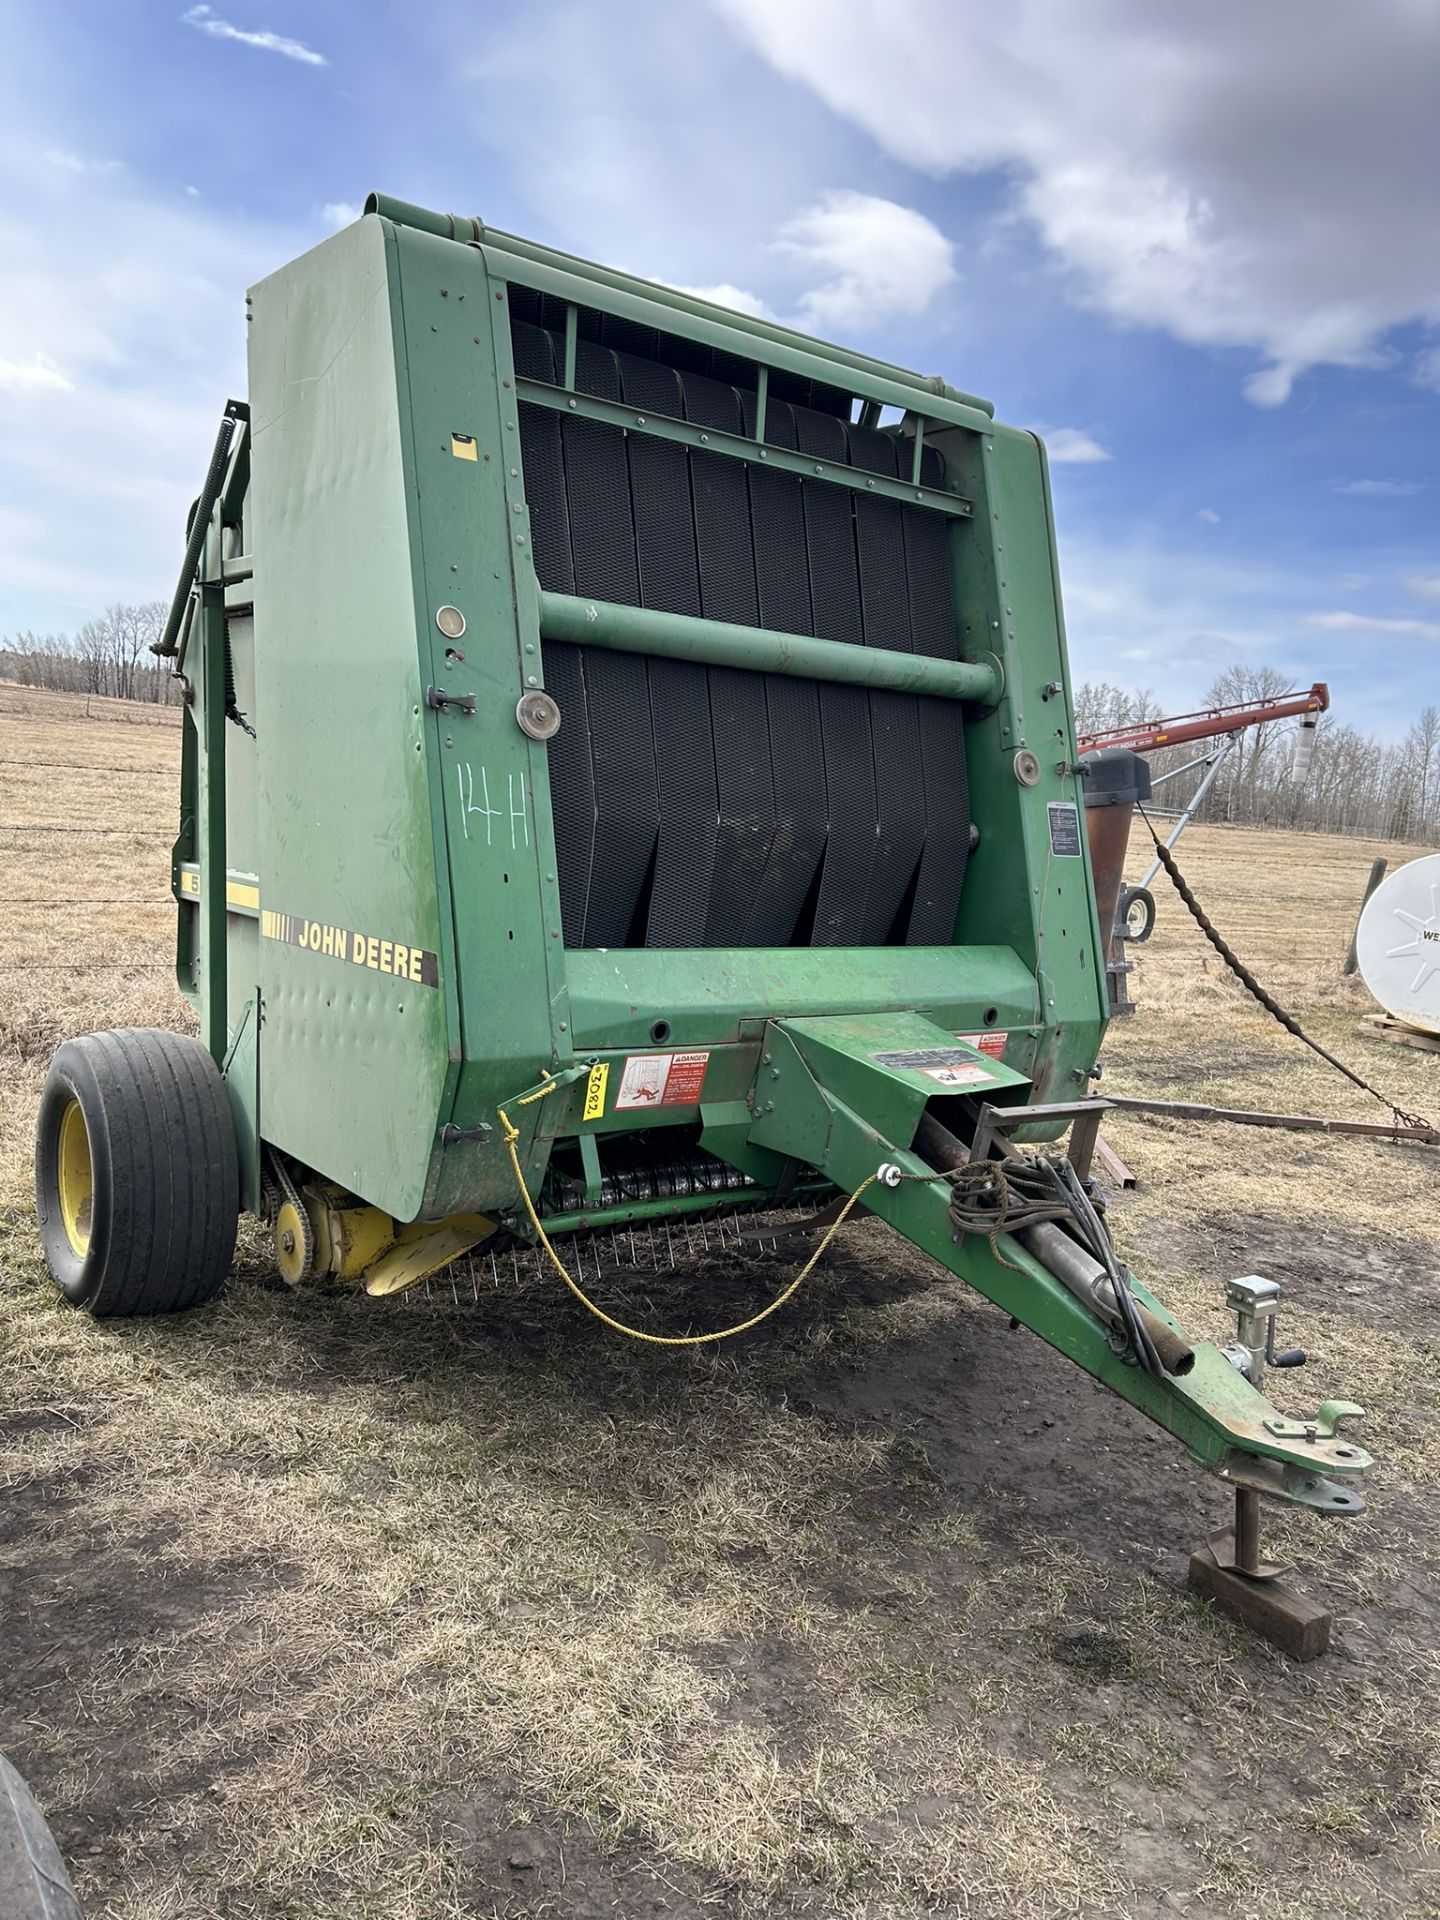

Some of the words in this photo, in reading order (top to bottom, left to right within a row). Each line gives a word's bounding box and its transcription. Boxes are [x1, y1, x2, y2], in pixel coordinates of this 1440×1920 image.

[1423, 930, 1440, 942] WE
[298, 919, 347, 960] JOHN
[353, 932, 423, 983] DEERE
[681, 1054, 707, 1062] DANGER
[587, 1073, 603, 1114] 3082
